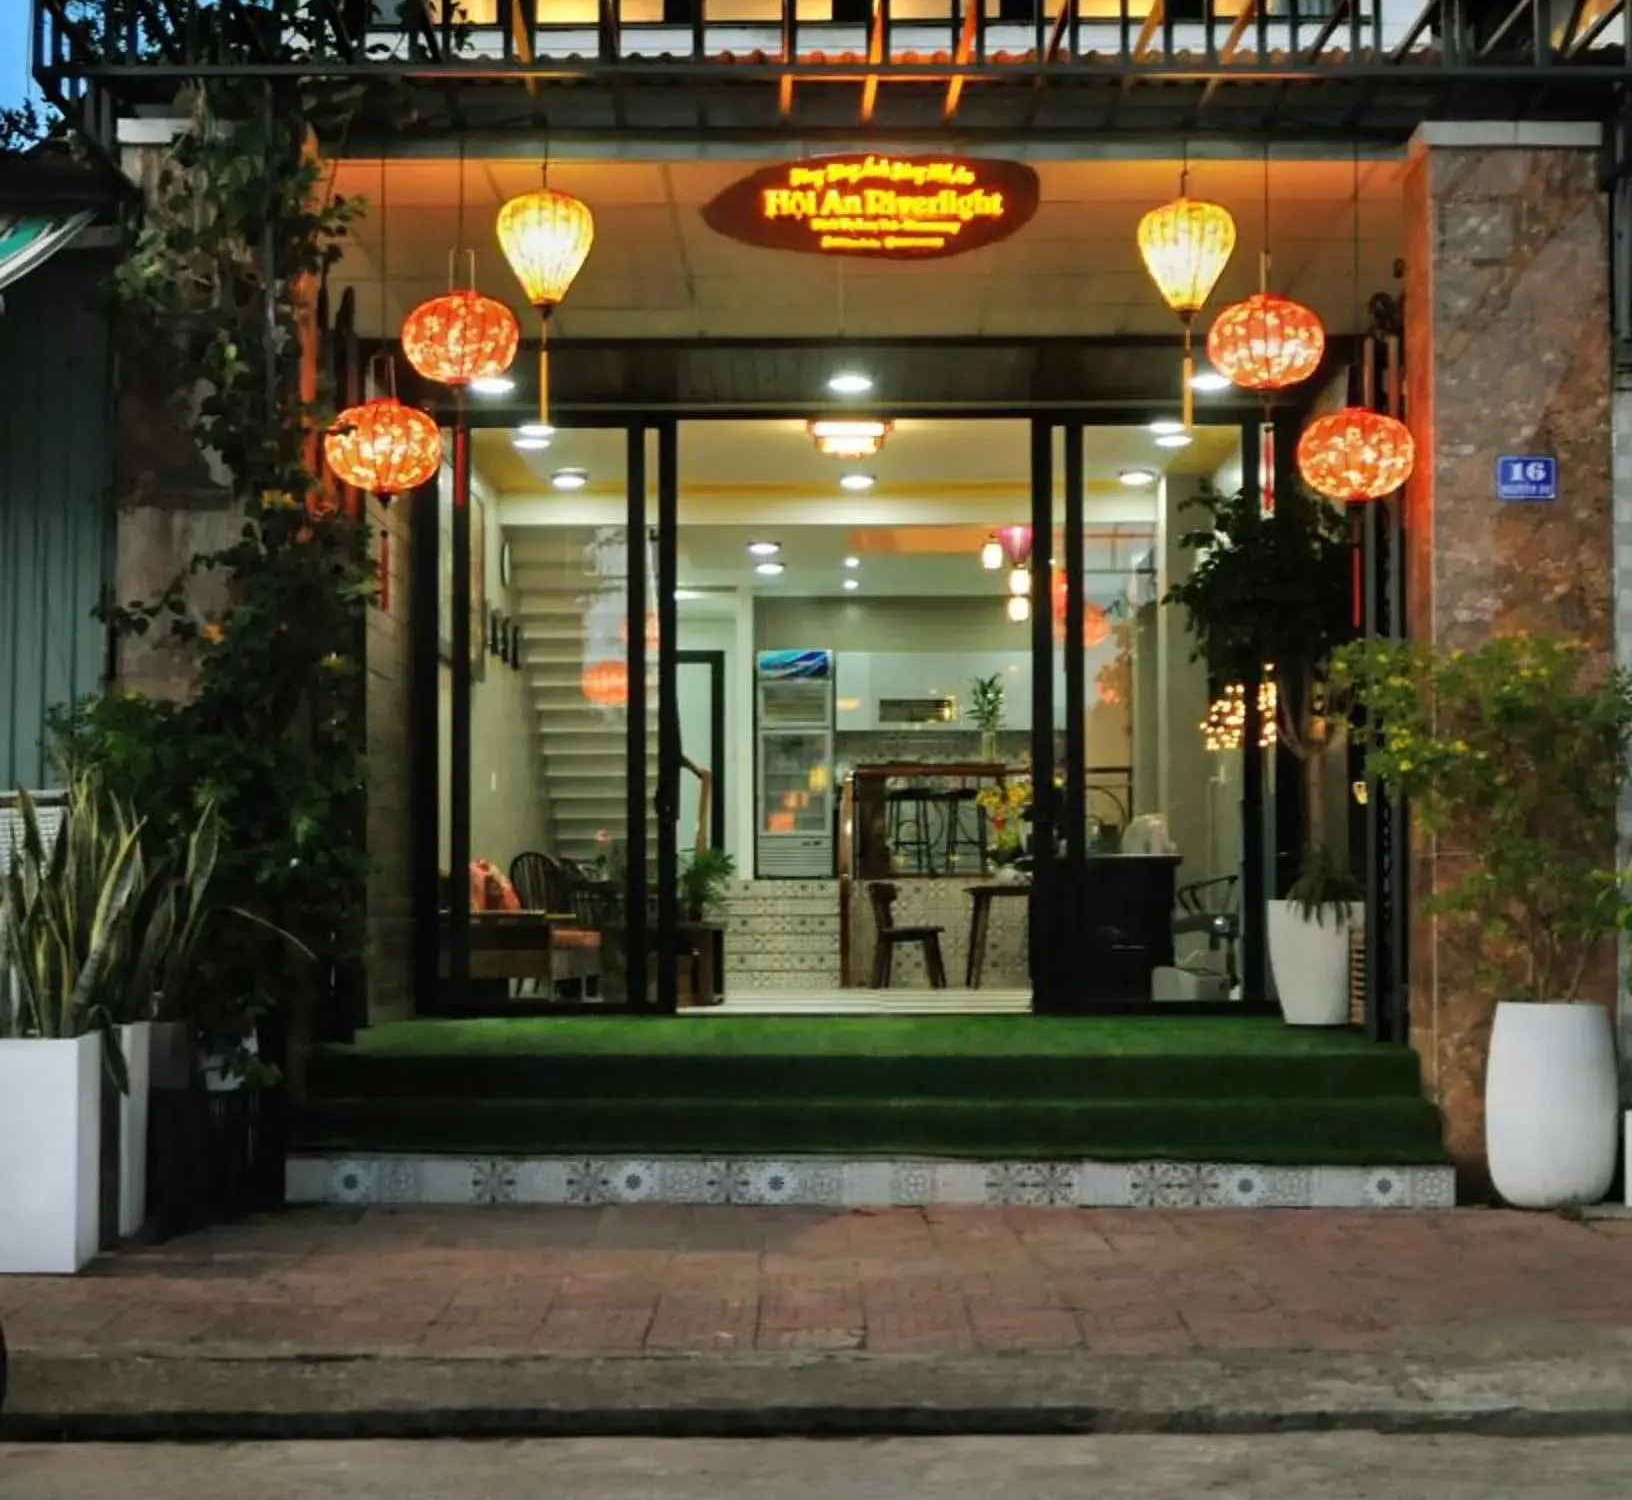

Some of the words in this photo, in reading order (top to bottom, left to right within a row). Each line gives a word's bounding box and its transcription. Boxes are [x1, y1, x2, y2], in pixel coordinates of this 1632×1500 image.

[820, 189, 863, 216] An
[864, 188, 1004, 222] Riverlight
[1509, 461, 1547, 482] 16
